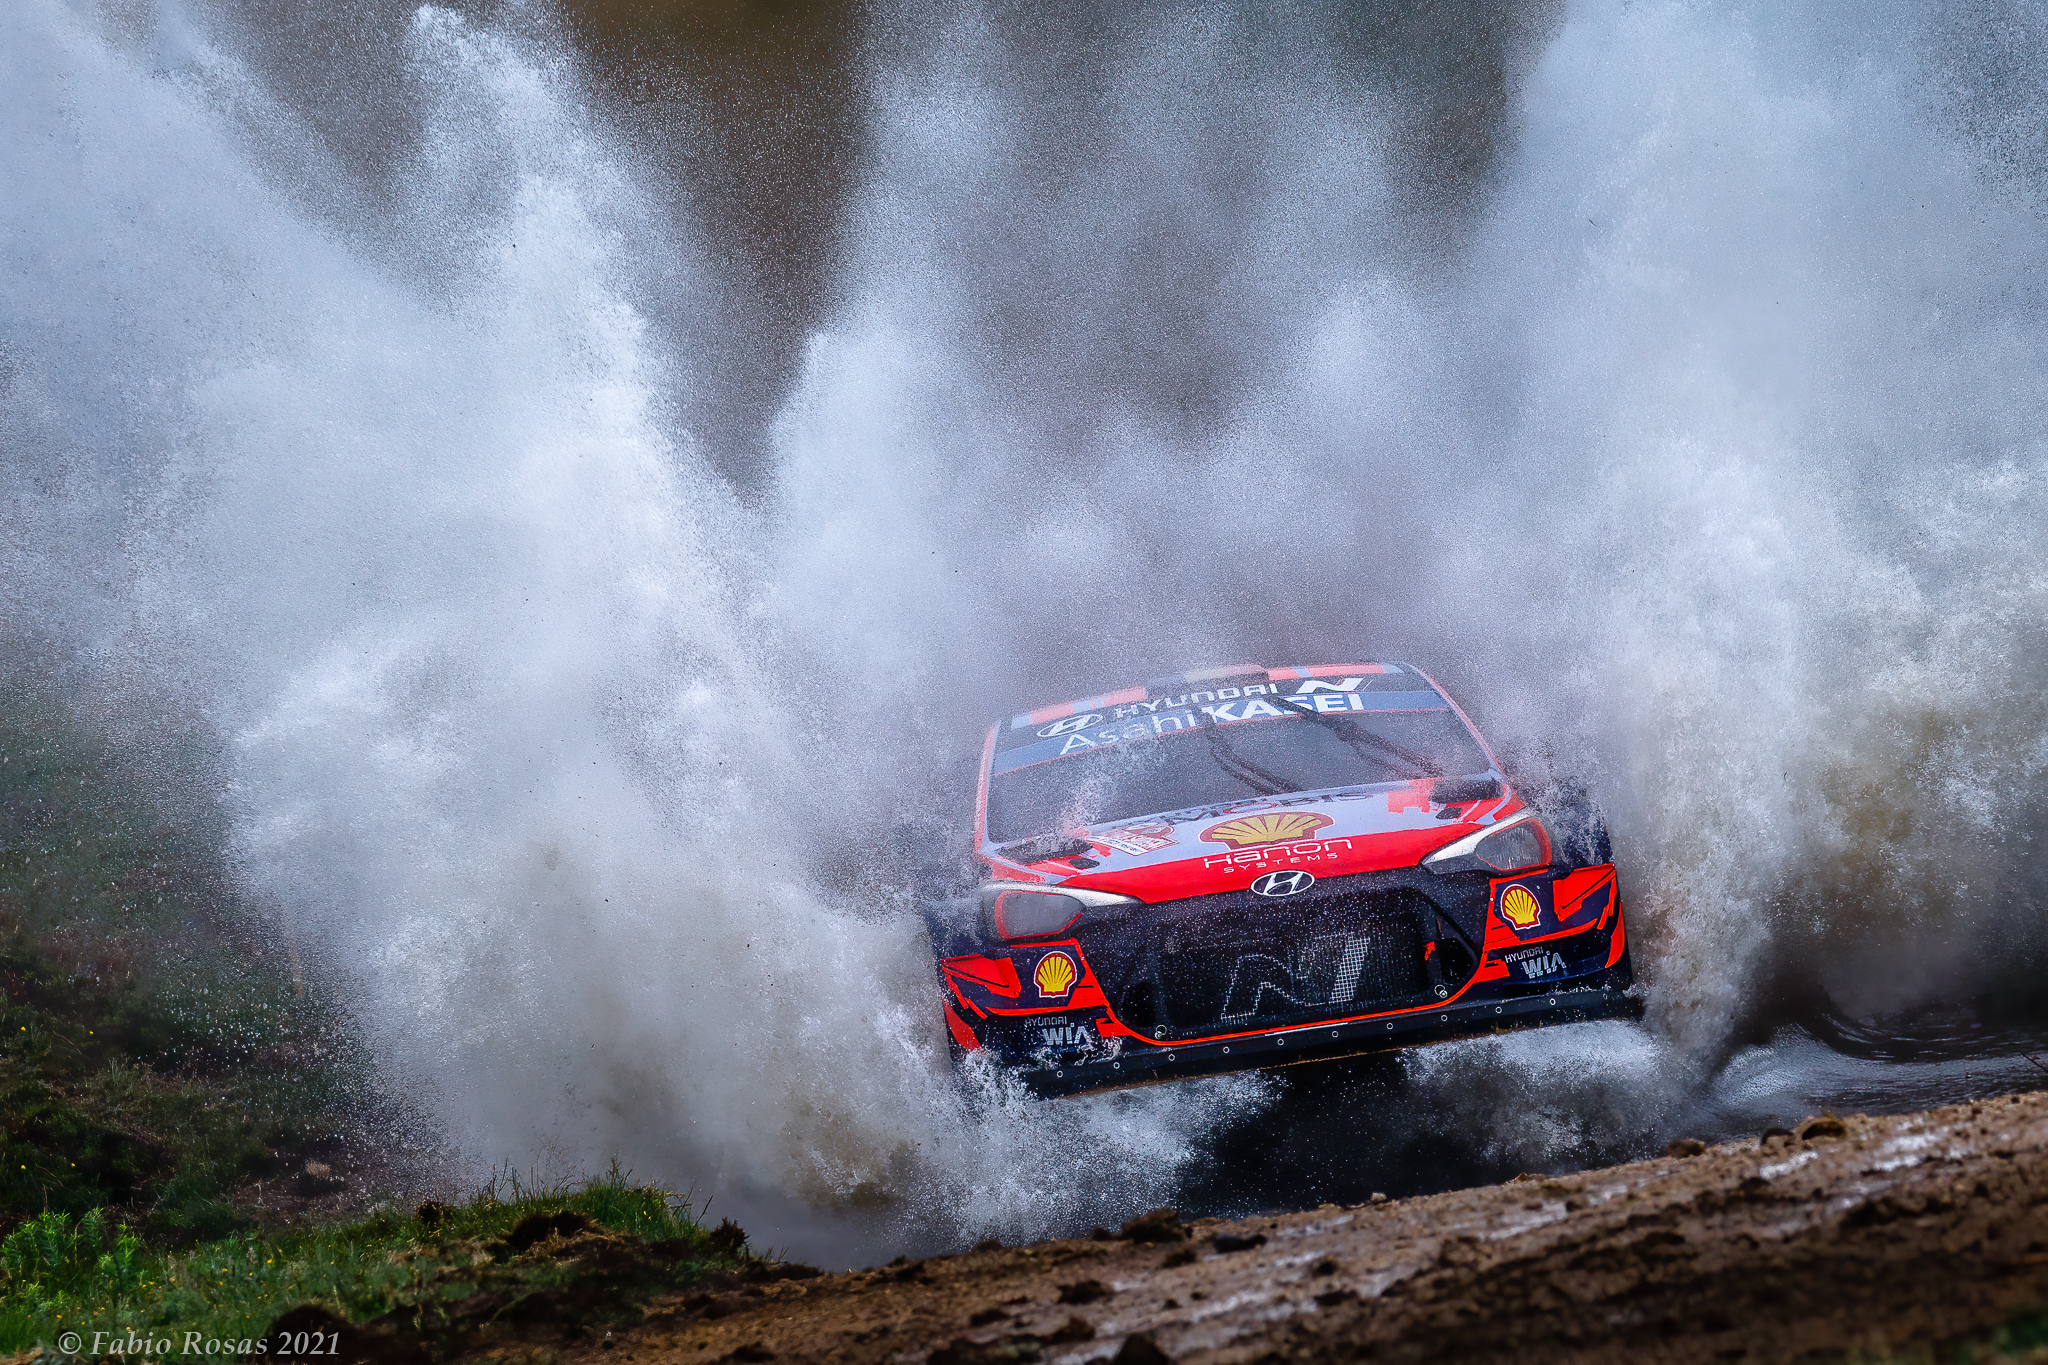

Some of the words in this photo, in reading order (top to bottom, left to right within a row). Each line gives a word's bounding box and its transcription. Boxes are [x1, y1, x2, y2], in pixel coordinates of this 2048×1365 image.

[1115, 683, 1279, 719] HYUNDAI
[1223, 852, 1339, 874] SYSTEMS
[1504, 946, 1544, 964] HYUNDAI
[1024, 1016, 1067, 1028] HYUNDAI
